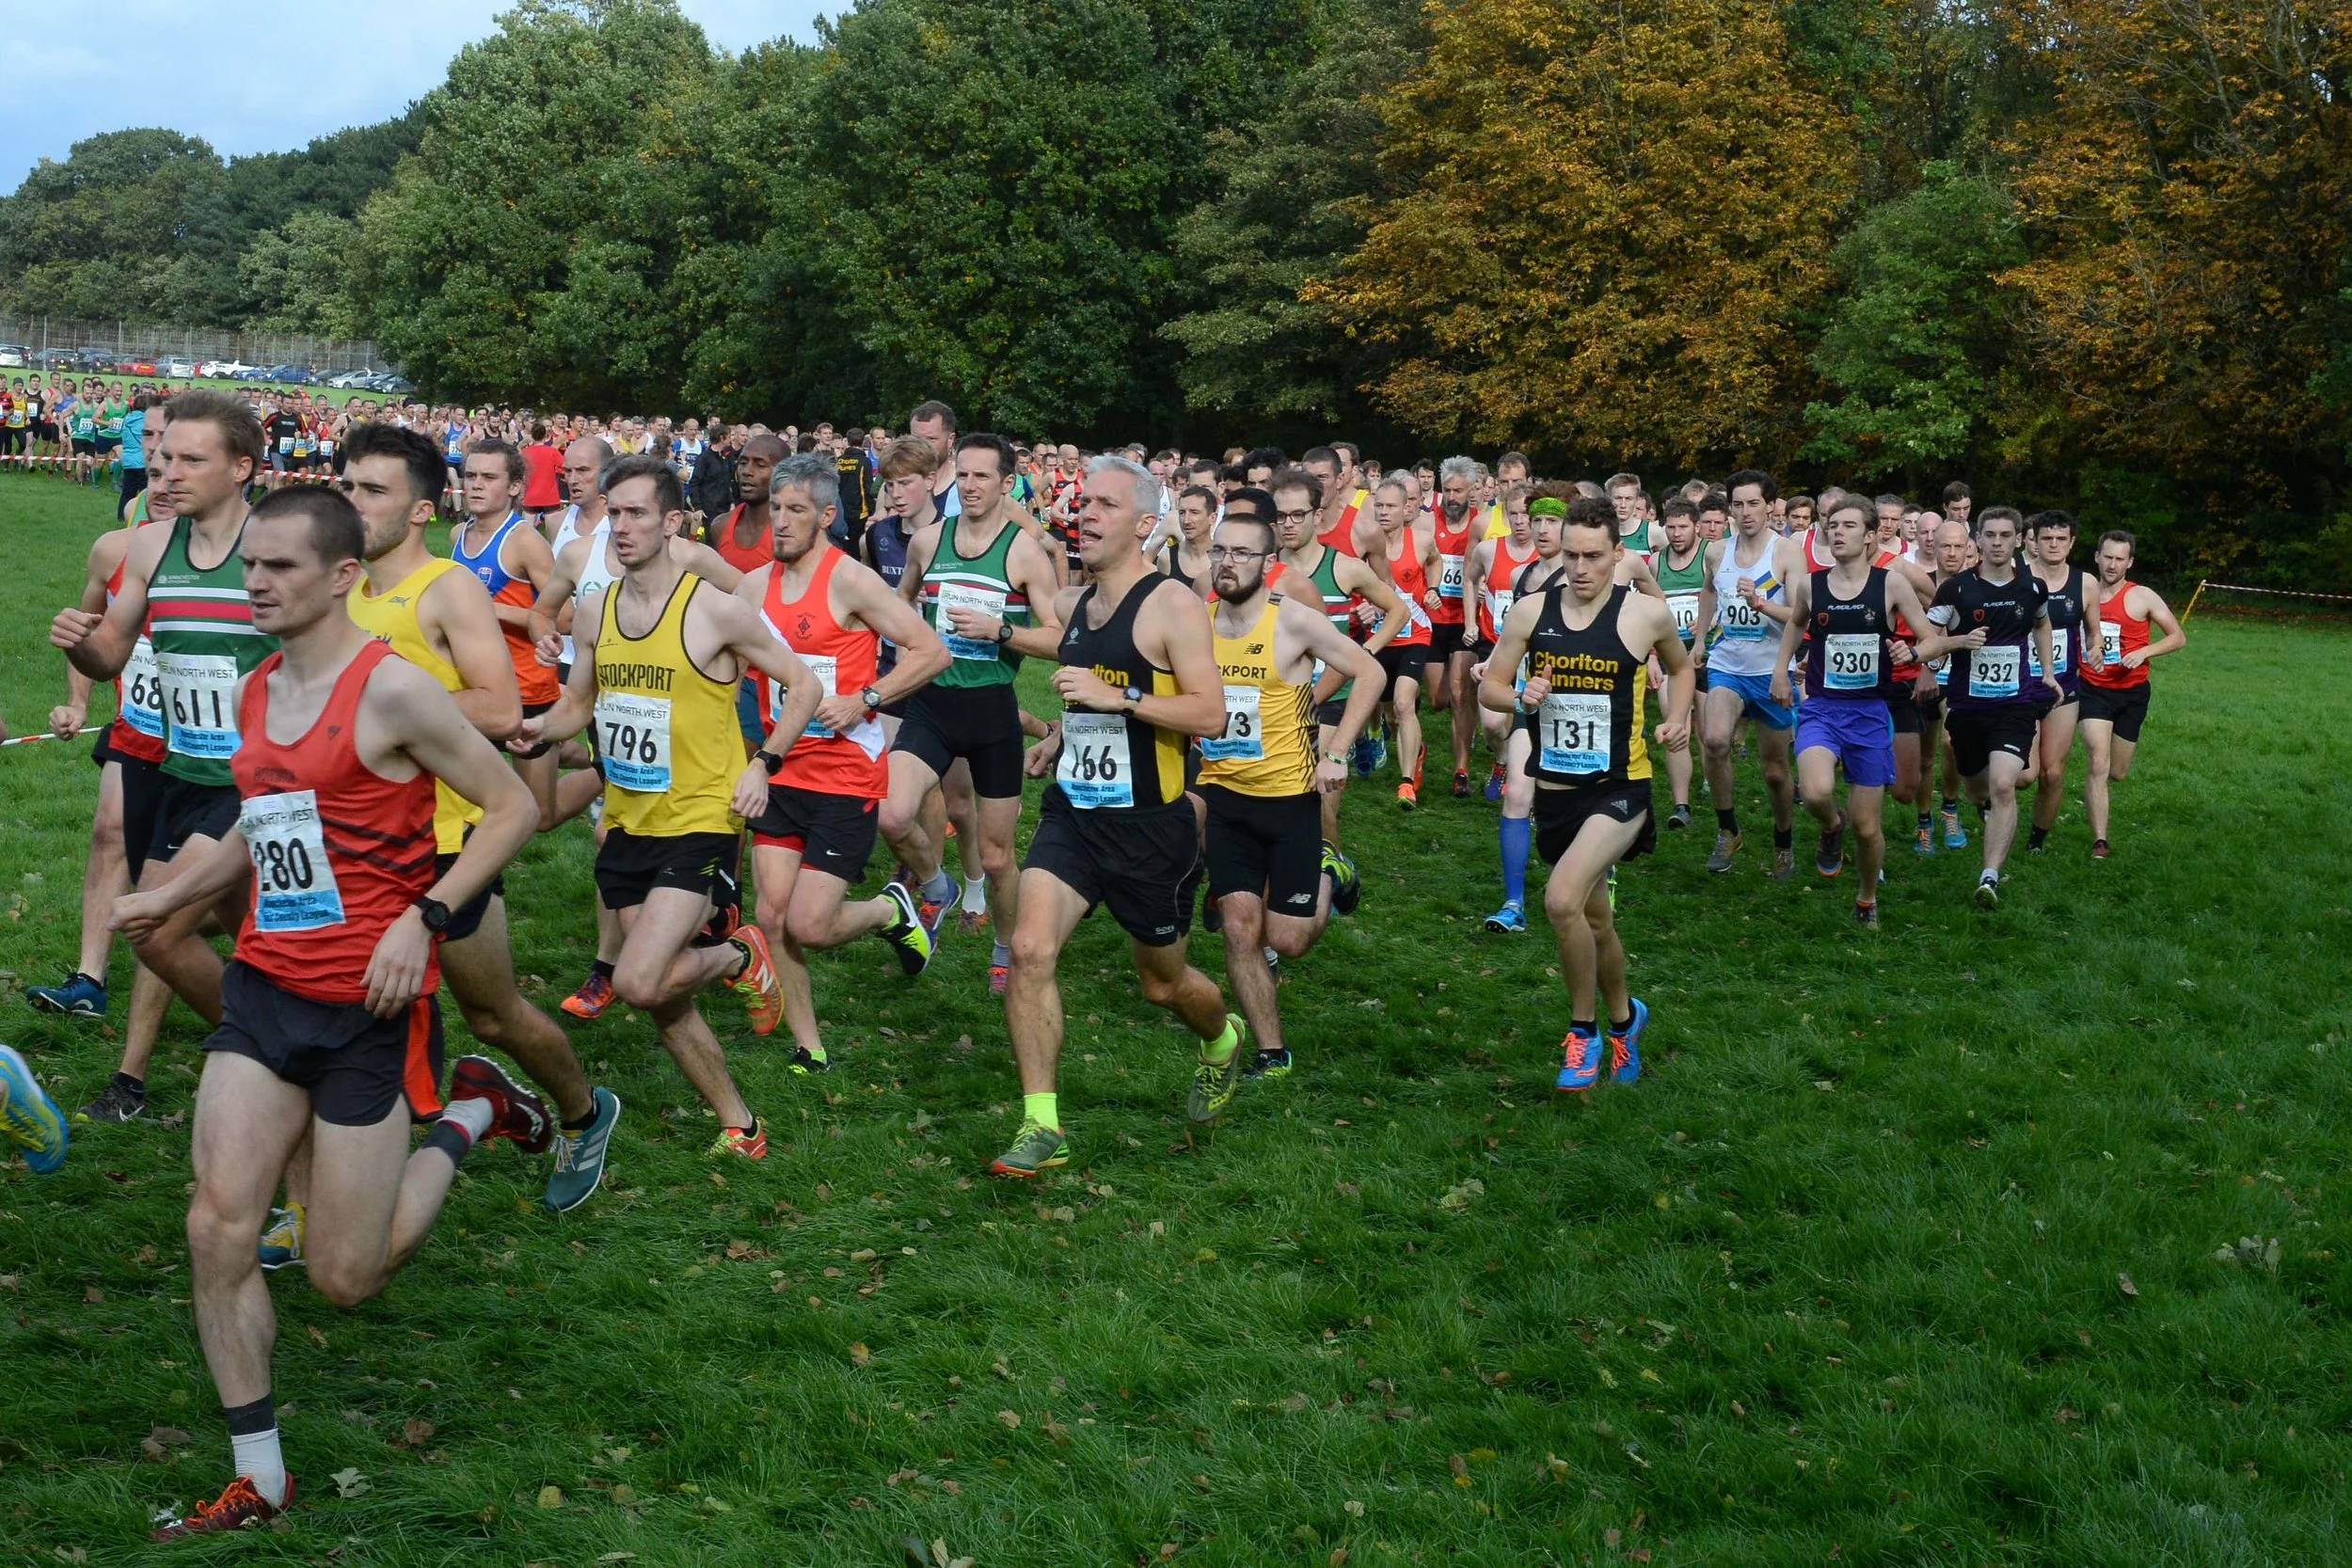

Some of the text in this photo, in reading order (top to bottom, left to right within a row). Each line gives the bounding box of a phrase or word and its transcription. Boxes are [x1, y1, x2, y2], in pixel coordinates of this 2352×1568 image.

[960, 595, 982, 605] NORTH
[984, 599, 1003, 609] WEST
[1726, 605, 1761, 626] 903
[1534, 651, 1619, 674] Chorlton
[1832, 652, 1871, 673] 930
[177, 668, 206, 678] NORTH
[207, 669, 234, 679] WEST
[1978, 662, 2013, 683] 932
[172, 687, 222, 728] 611
[1239, 695, 1257, 704] WEST
[1558, 704, 1585, 712] NORTH
[1586, 705, 1609, 713] WEST
[615, 705, 641, 717] NORTH
[643, 708, 668, 720] WEST
[1074, 724, 1099, 735] NORTH
[1099, 725, 1123, 735] WEST
[1552, 719, 1595, 751] 131
[605, 721, 658, 765] 796
[289, 808, 314, 823] WEST
